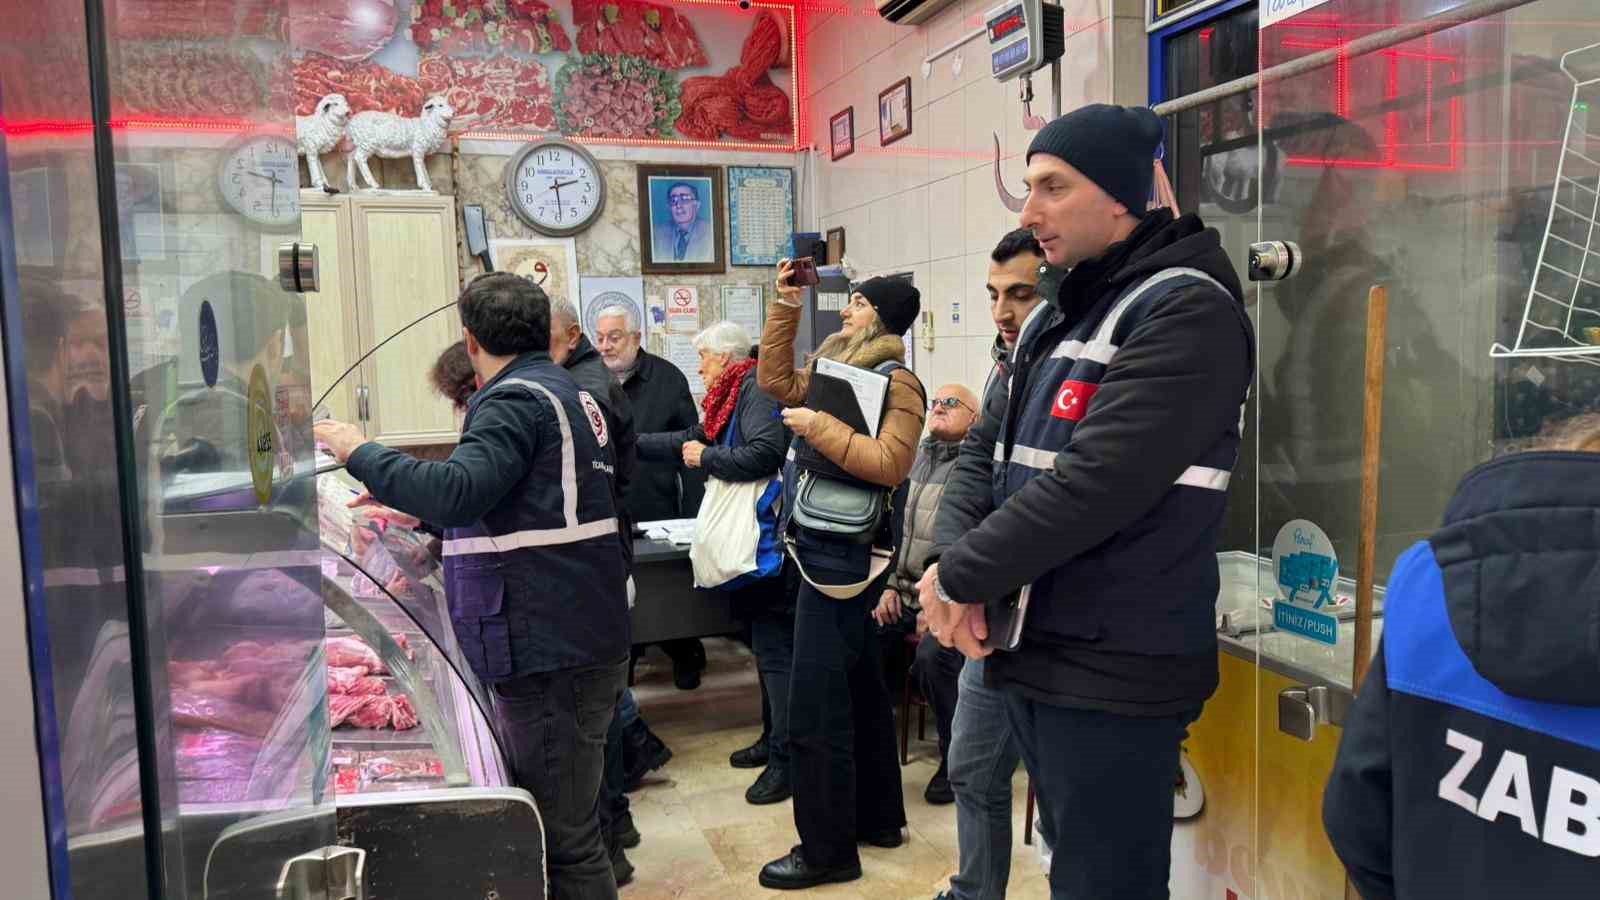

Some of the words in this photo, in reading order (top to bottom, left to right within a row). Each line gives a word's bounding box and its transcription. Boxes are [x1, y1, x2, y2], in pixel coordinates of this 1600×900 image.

[537, 154, 544, 166] 11
[549, 151, 561, 161] 12
[525, 167, 535, 178] 10
[580, 168, 586, 178] 2
[520, 181, 529, 191] 9
[584, 182, 592, 192] 3
[526, 194, 534, 204] 8
[538, 207, 545, 217] 7
[570, 207, 578, 217] 5
[1438, 728, 1600, 857] ZAB
